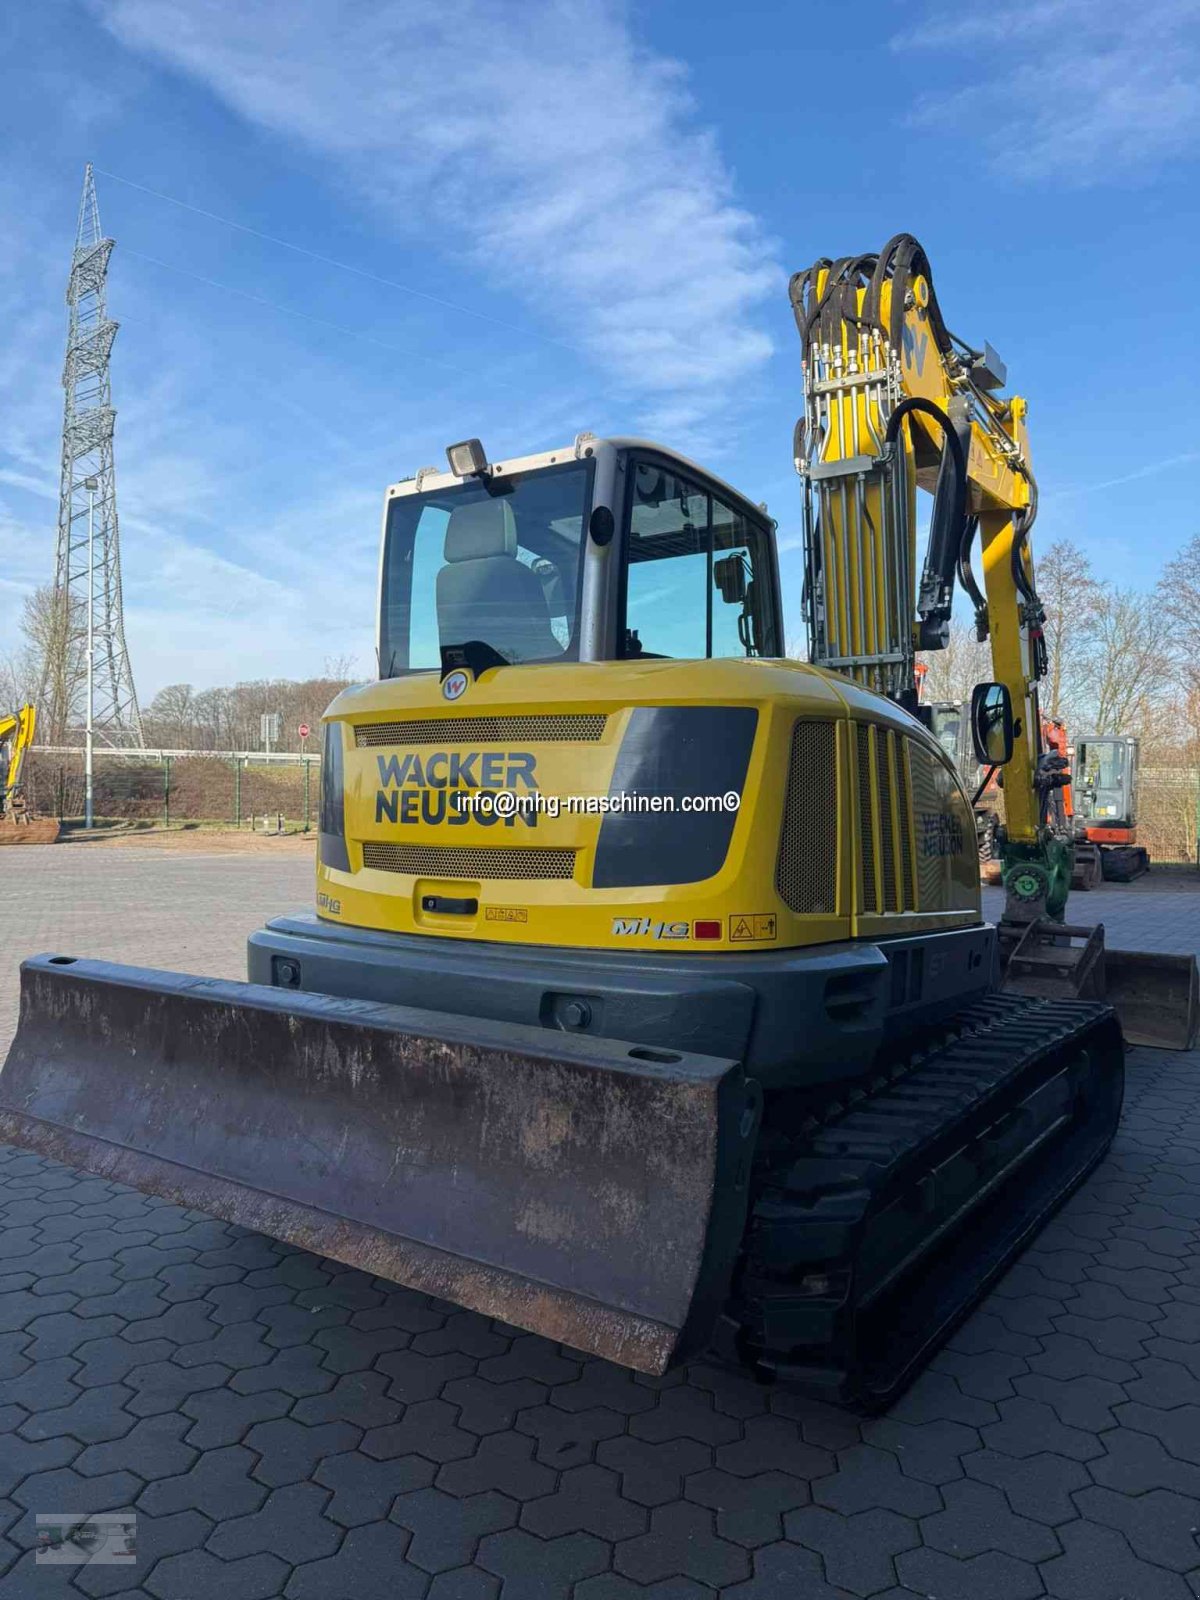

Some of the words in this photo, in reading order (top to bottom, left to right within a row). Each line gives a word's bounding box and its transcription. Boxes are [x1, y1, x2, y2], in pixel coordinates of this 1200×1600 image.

[376, 752, 539, 789] WACKER
[375, 789, 538, 828] NEUSON
[612, 917, 690, 940] MHG
